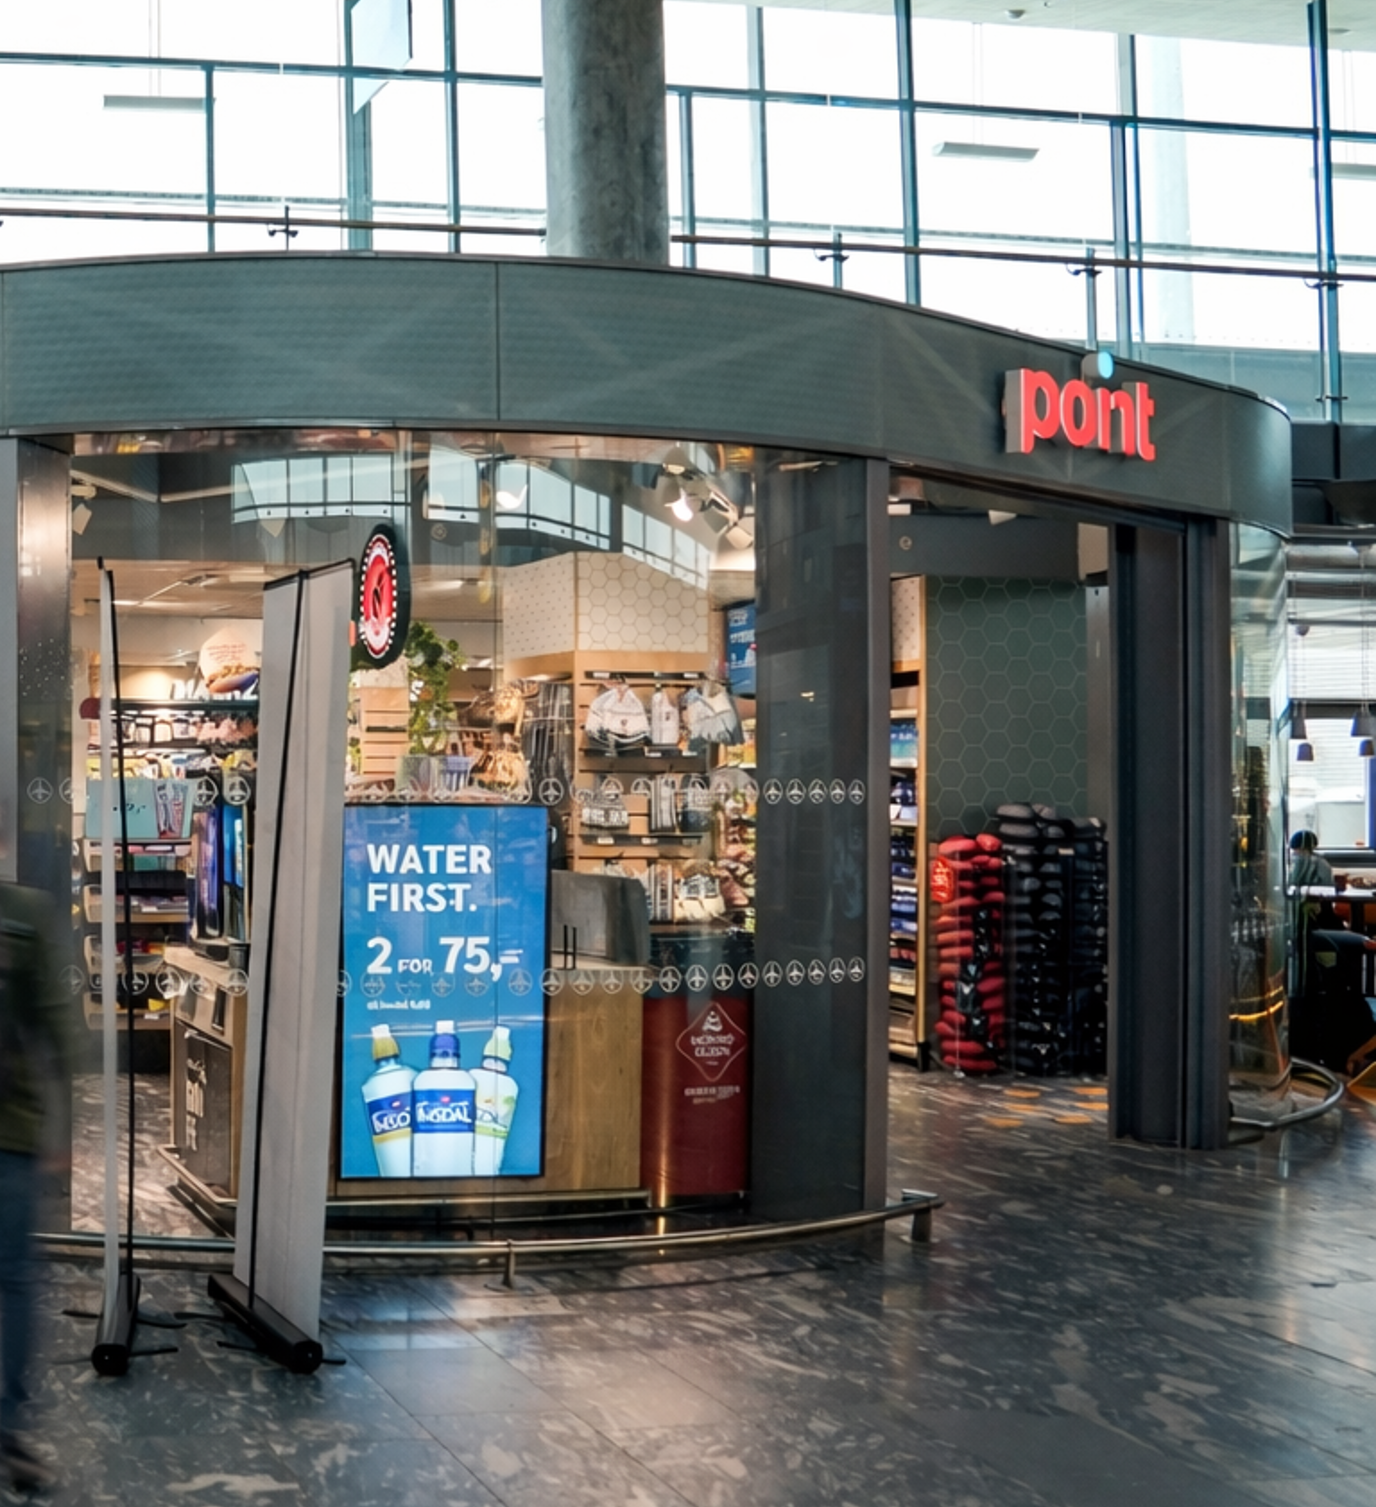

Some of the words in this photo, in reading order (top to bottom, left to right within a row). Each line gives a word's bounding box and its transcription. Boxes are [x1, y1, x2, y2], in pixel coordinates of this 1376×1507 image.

[1005, 350, 1156, 462] point
[366, 843, 492, 874] WATER
[367, 882, 478, 912] FIRST.
[366, 936, 393, 975] 2
[397, 958, 433, 974] FOR
